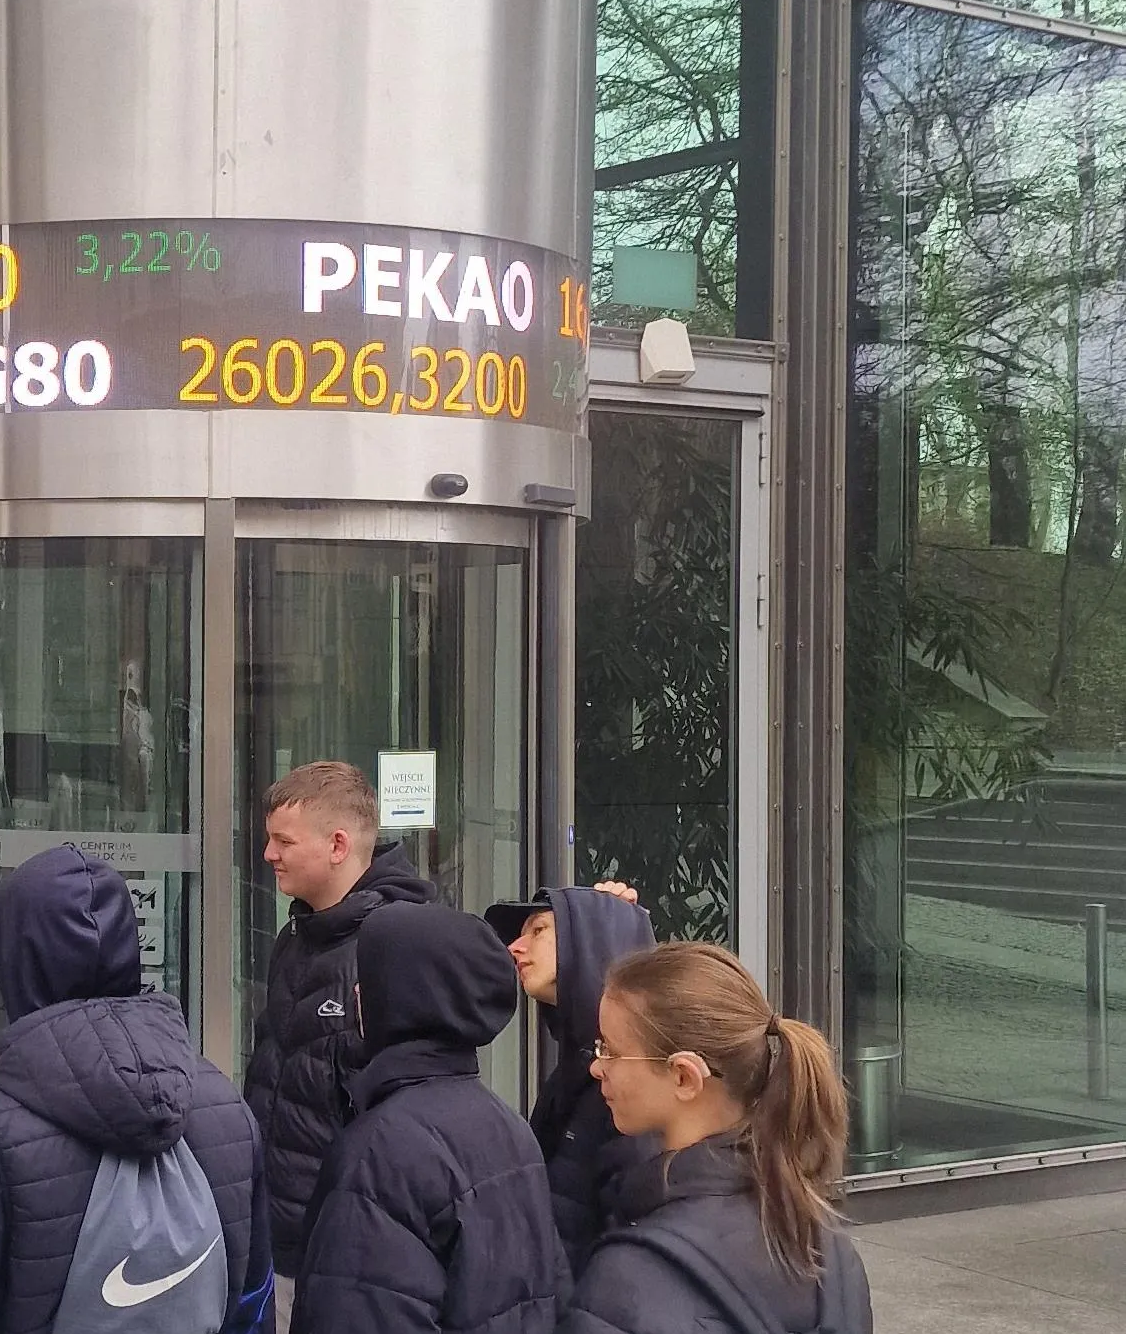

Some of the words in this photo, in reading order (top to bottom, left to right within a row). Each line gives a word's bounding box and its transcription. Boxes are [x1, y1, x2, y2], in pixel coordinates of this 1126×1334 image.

[76, 229, 221, 282] 3,22%
[179, 338, 525, 418] 26026,3200
[80, 841, 132, 851] CENTRUM
